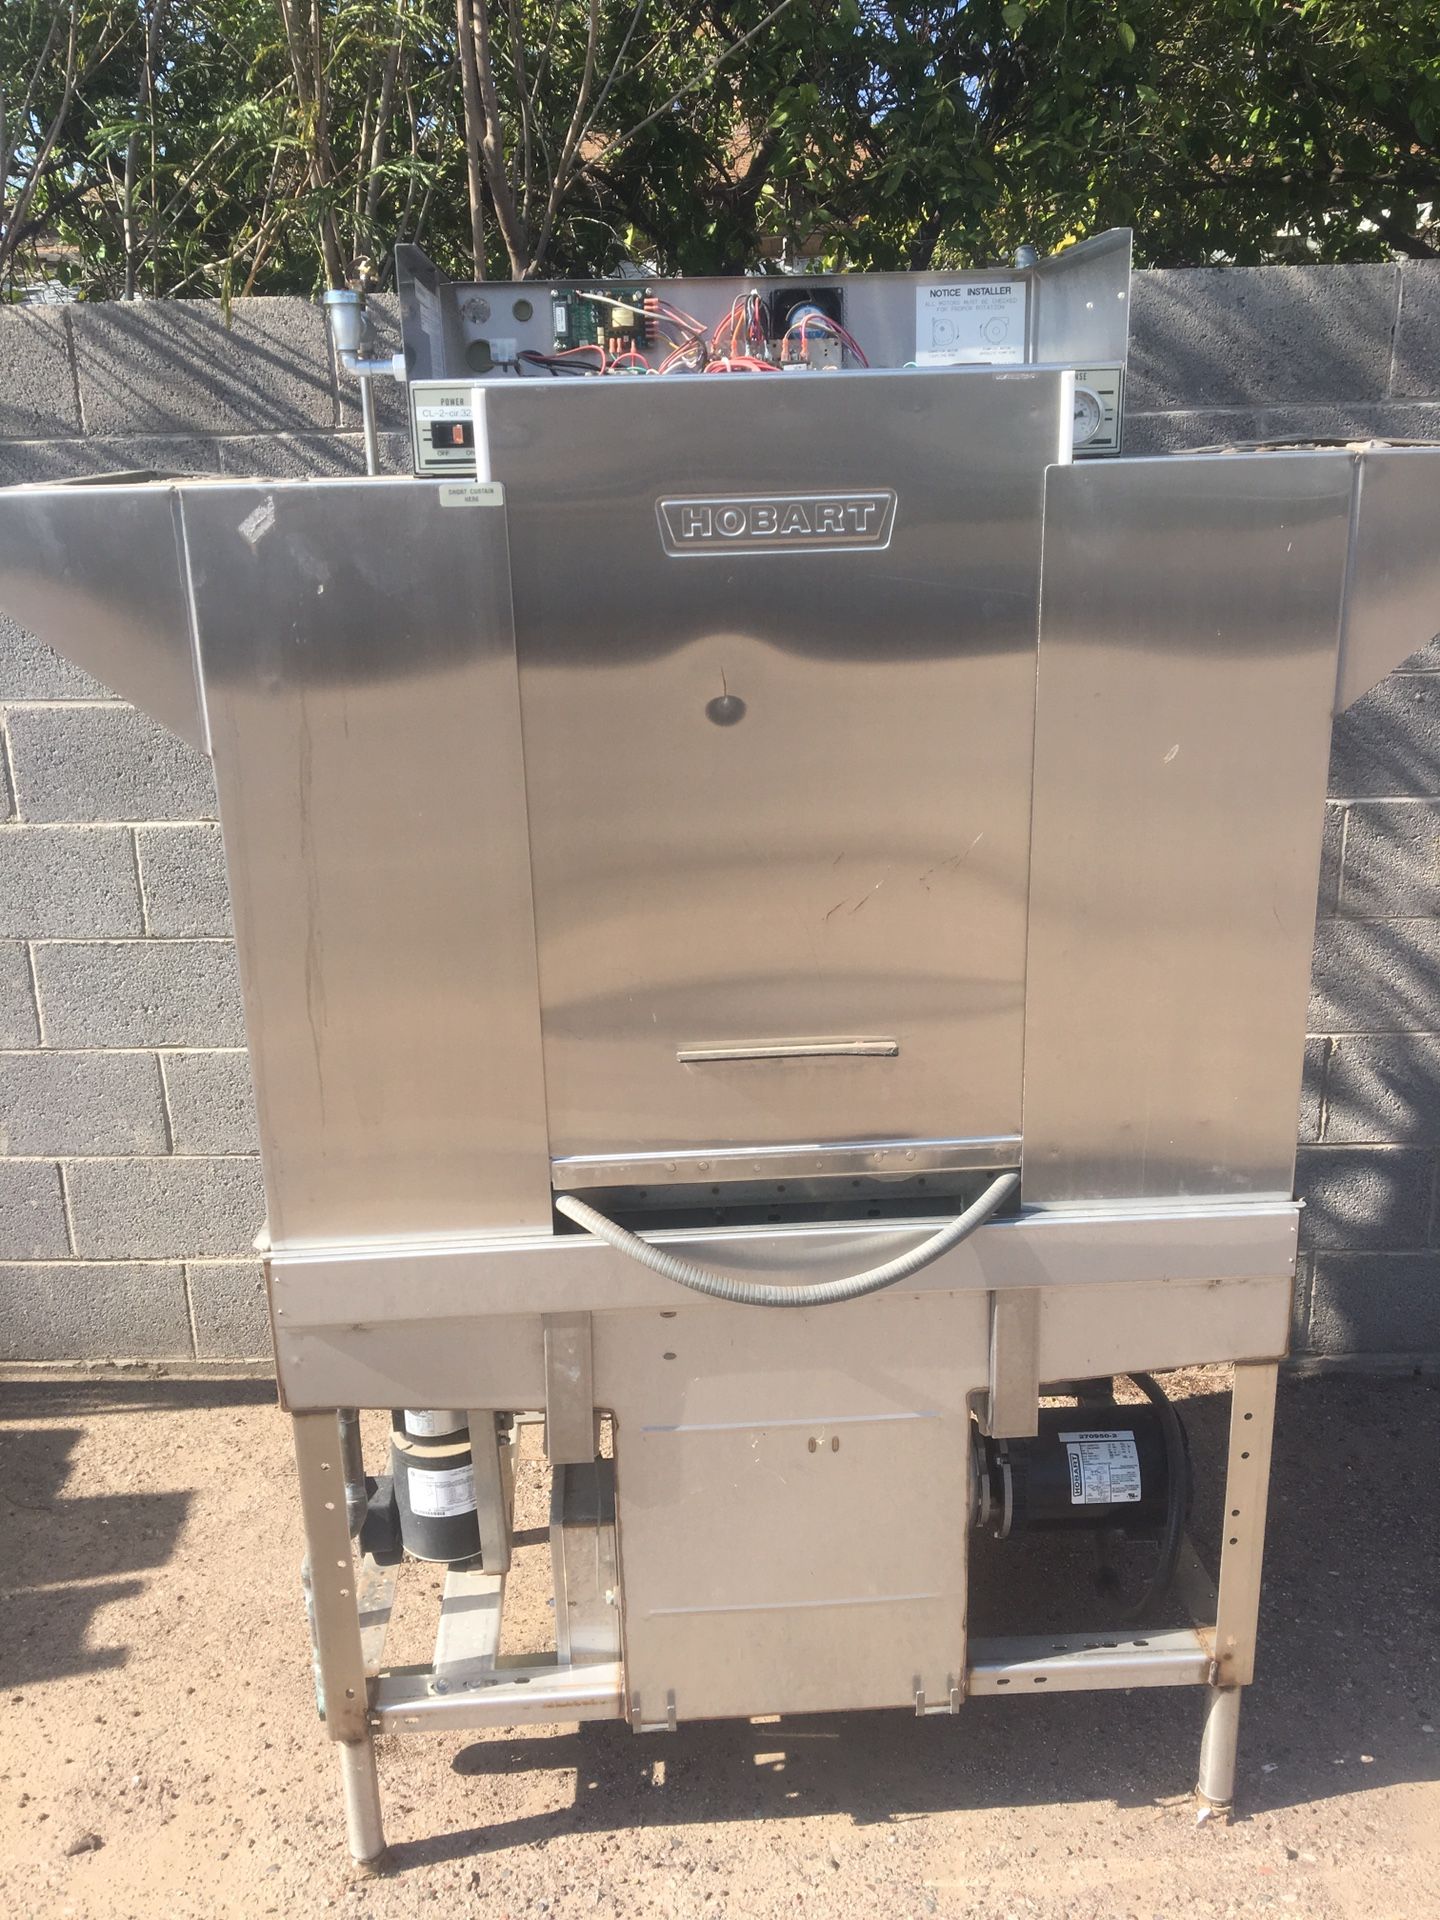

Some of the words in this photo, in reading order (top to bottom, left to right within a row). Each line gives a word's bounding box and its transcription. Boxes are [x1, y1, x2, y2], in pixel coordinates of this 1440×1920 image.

[930, 288, 961, 298] NOTICE
[967, 286, 1012, 296] INSTALLER
[440, 398, 464, 406] POWER
[682, 503, 876, 537] HOBART
[1072, 1456, 1080, 1494] HOBART
